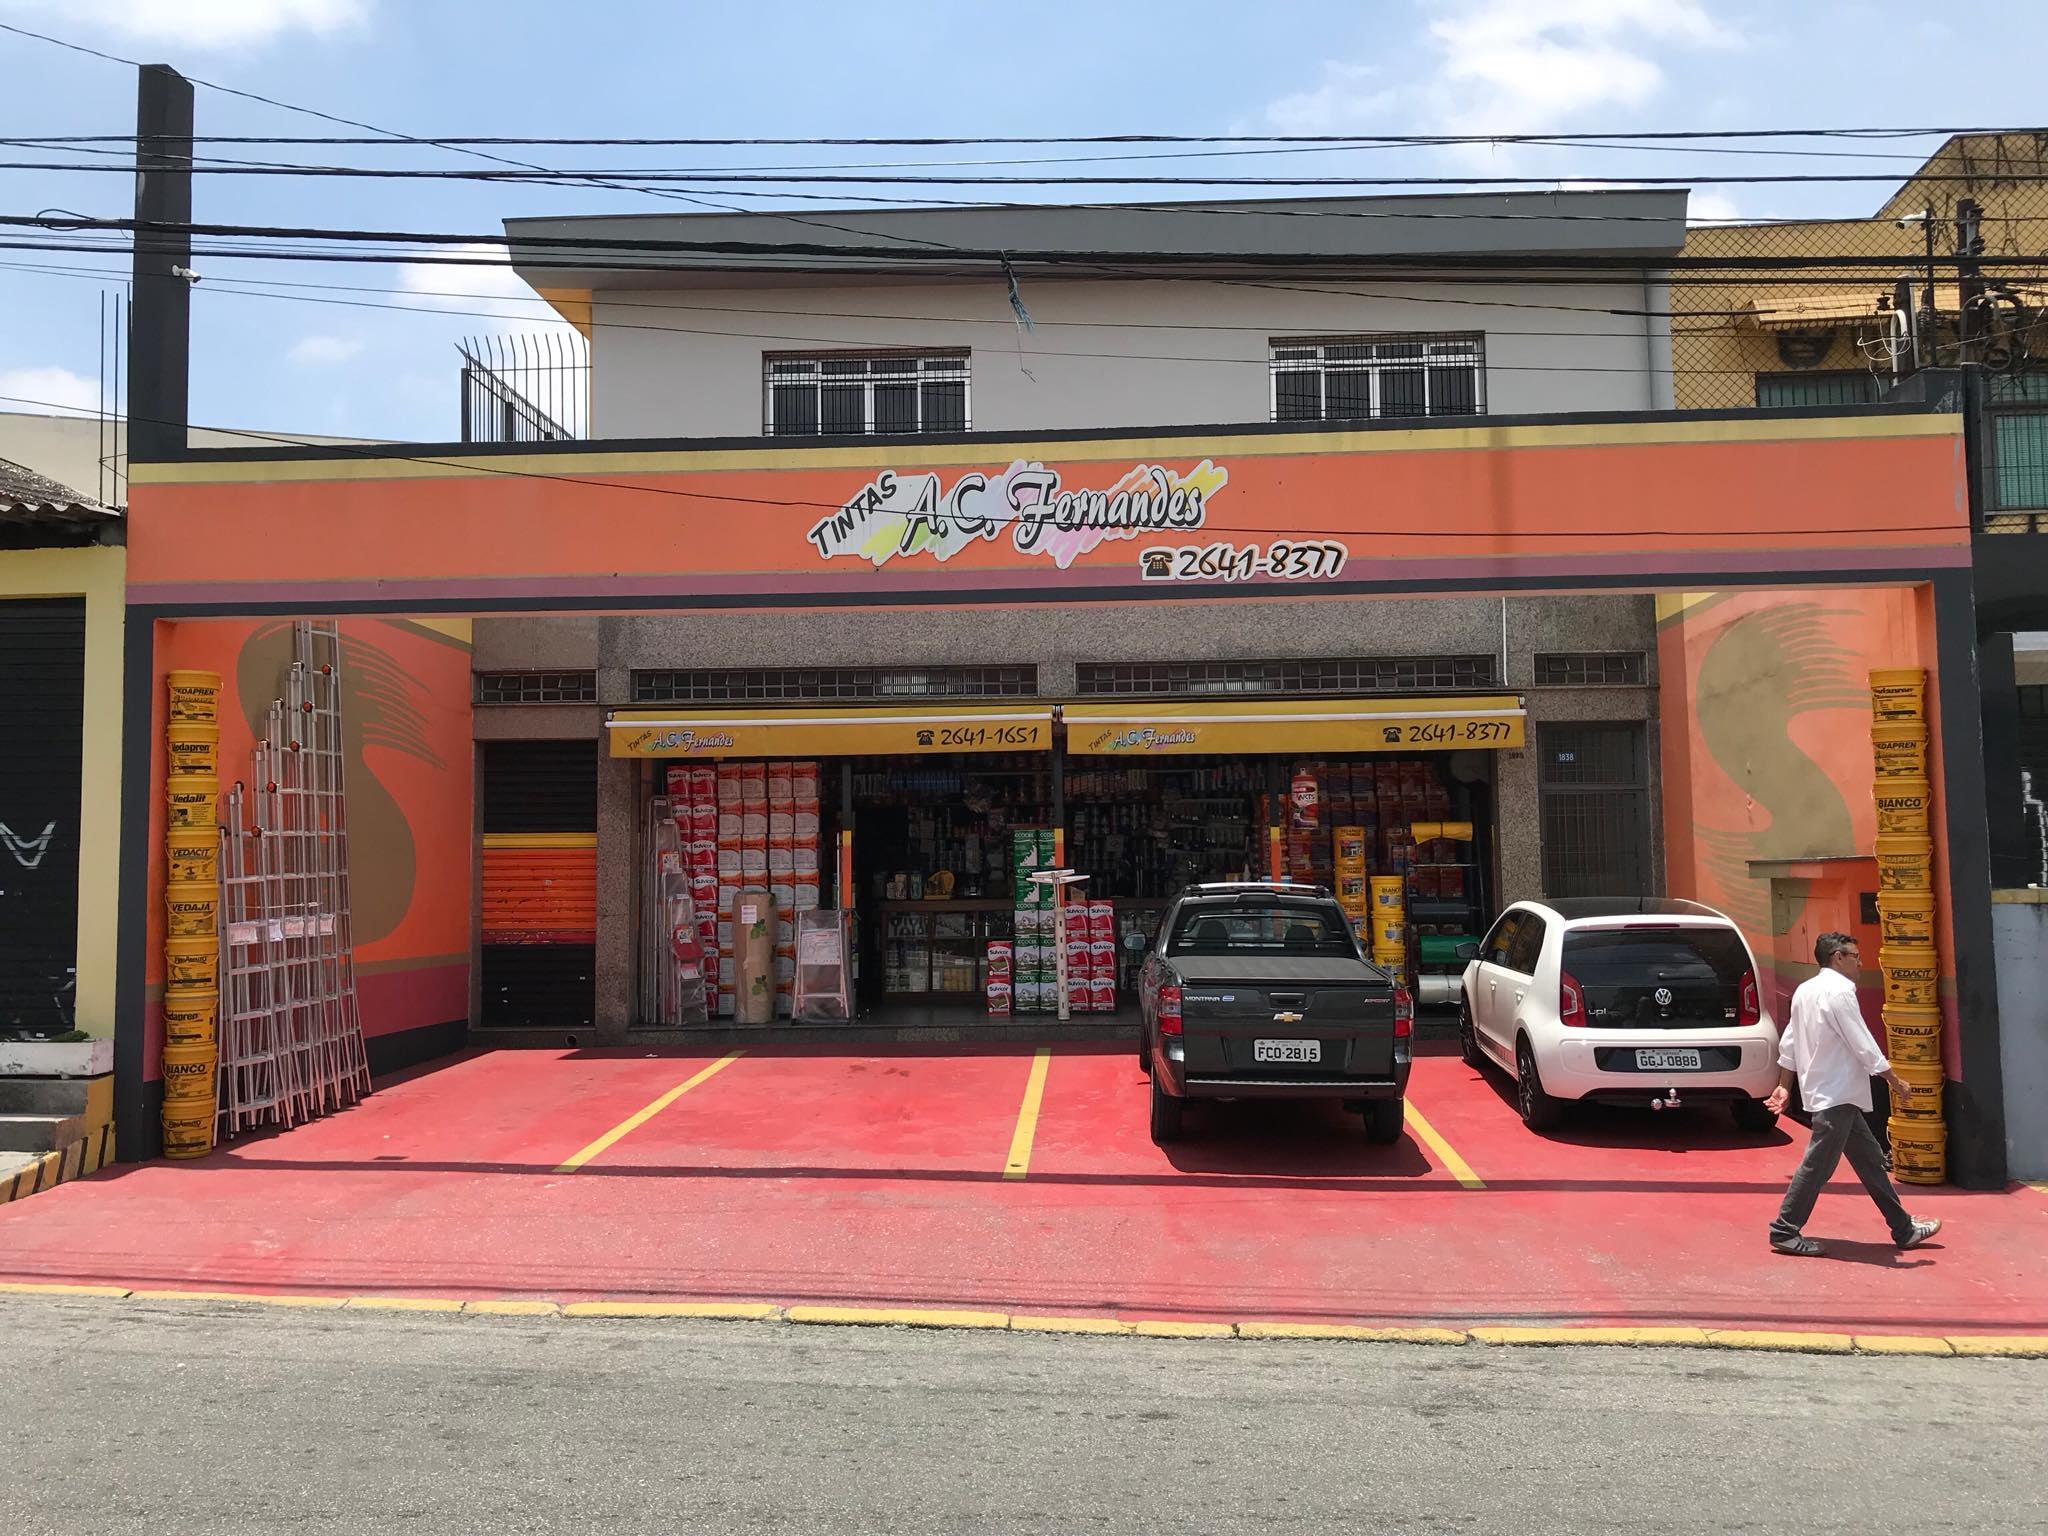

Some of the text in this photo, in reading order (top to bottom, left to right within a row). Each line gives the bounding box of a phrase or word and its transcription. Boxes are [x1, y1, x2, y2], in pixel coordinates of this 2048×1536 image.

[810, 468, 1202, 555] TINTAS A.C. Fernandes
[1179, 545, 1342, 578] 2641-8377
[628, 730, 733, 752] TINTAS A.C. Fernandes
[940, 726, 1038, 746] 2641-1651
[1088, 728, 1196, 752] TINTAS A.C. Fernandes
[1409, 722, 1511, 742] 2641-8377
[1558, 752, 1574, 761] 1838
[1878, 798, 1921, 808] BIANCO
[173, 847, 210, 857] VEDACIT
[1891, 968, 1931, 978] VEDACIT
